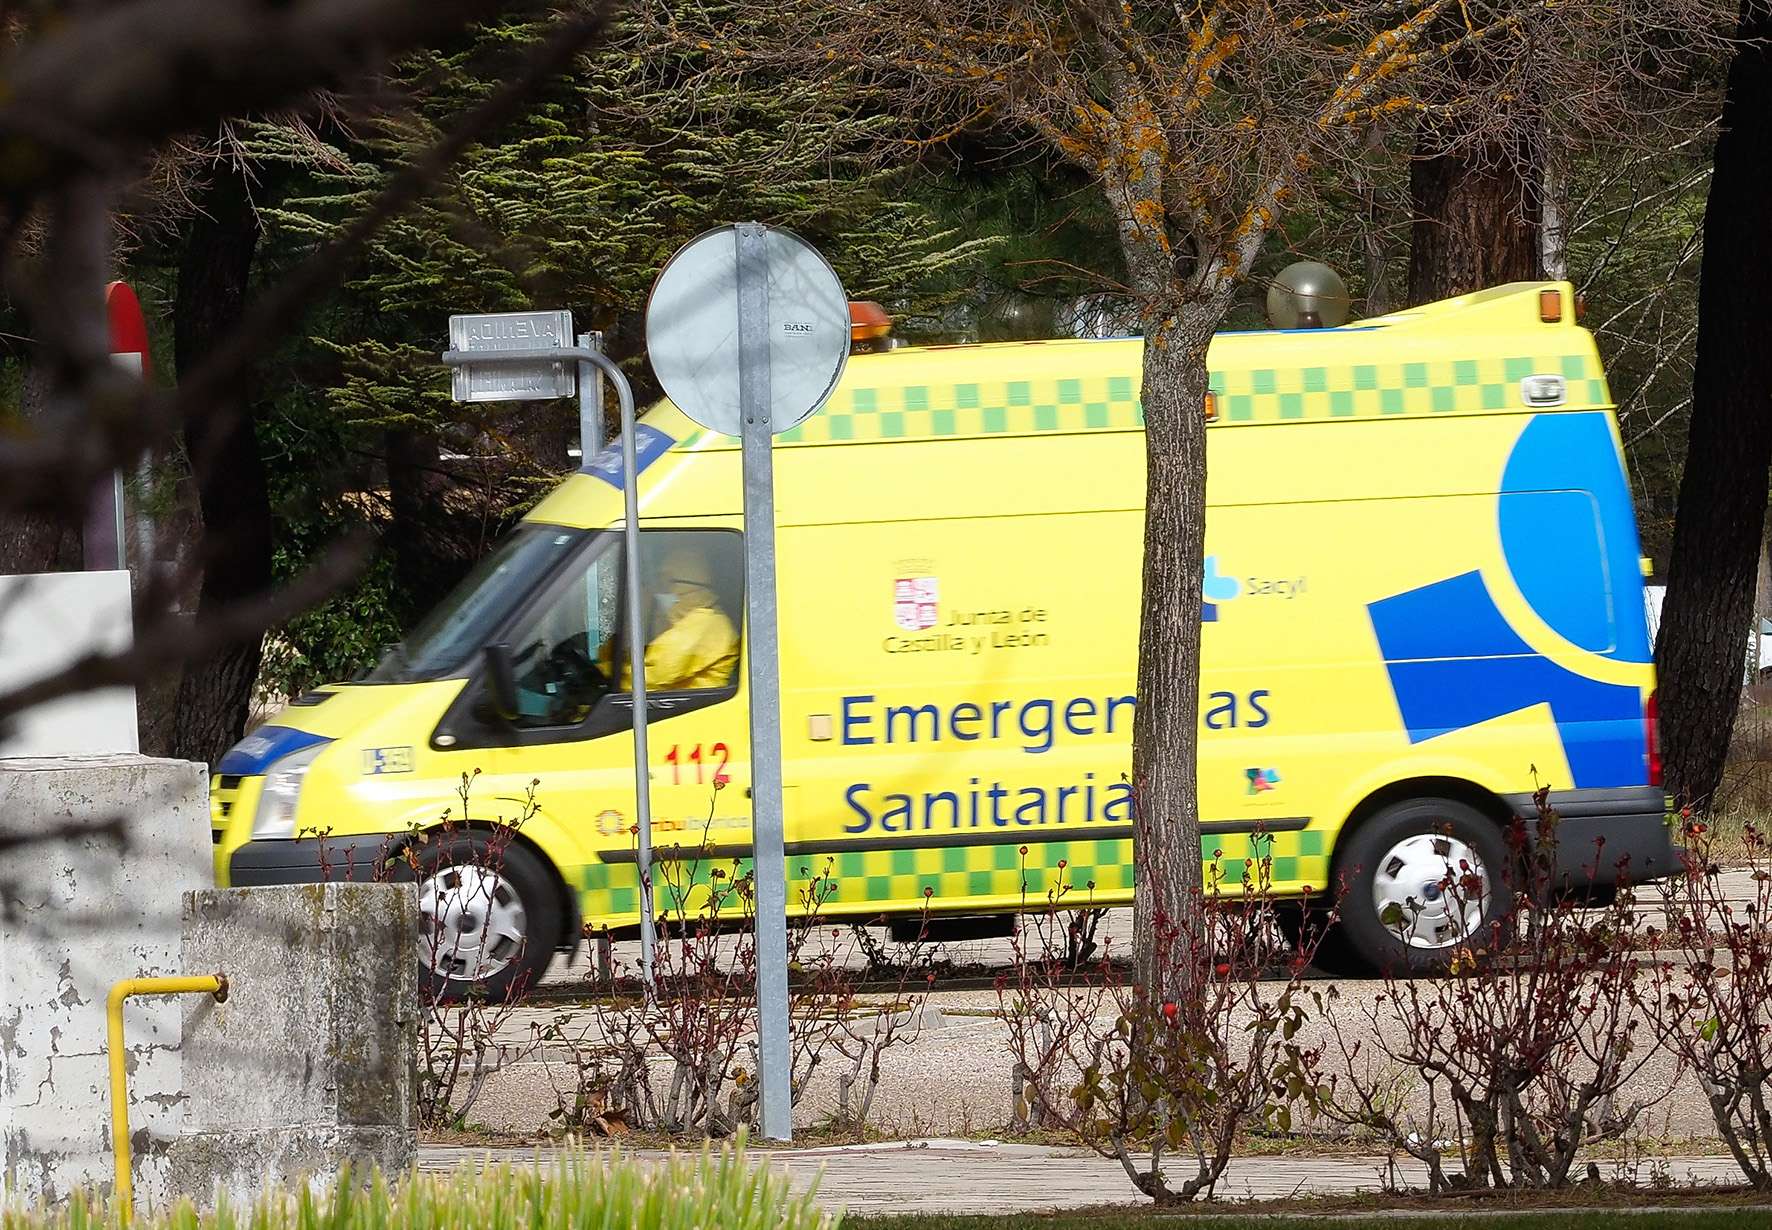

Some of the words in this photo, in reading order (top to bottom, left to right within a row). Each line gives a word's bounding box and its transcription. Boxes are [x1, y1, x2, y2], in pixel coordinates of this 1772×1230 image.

[1246, 576, 1307, 600] Sacyl
[945, 610, 1013, 627] Junta
[1018, 606, 1047, 623] de
[883, 633, 965, 654] Castilla
[970, 636, 984, 655] y
[991, 629, 1049, 648] León
[841, 689, 1270, 754] Emergenas
[665, 742, 731, 785] 112
[844, 773, 1133, 833] Sanitaria
